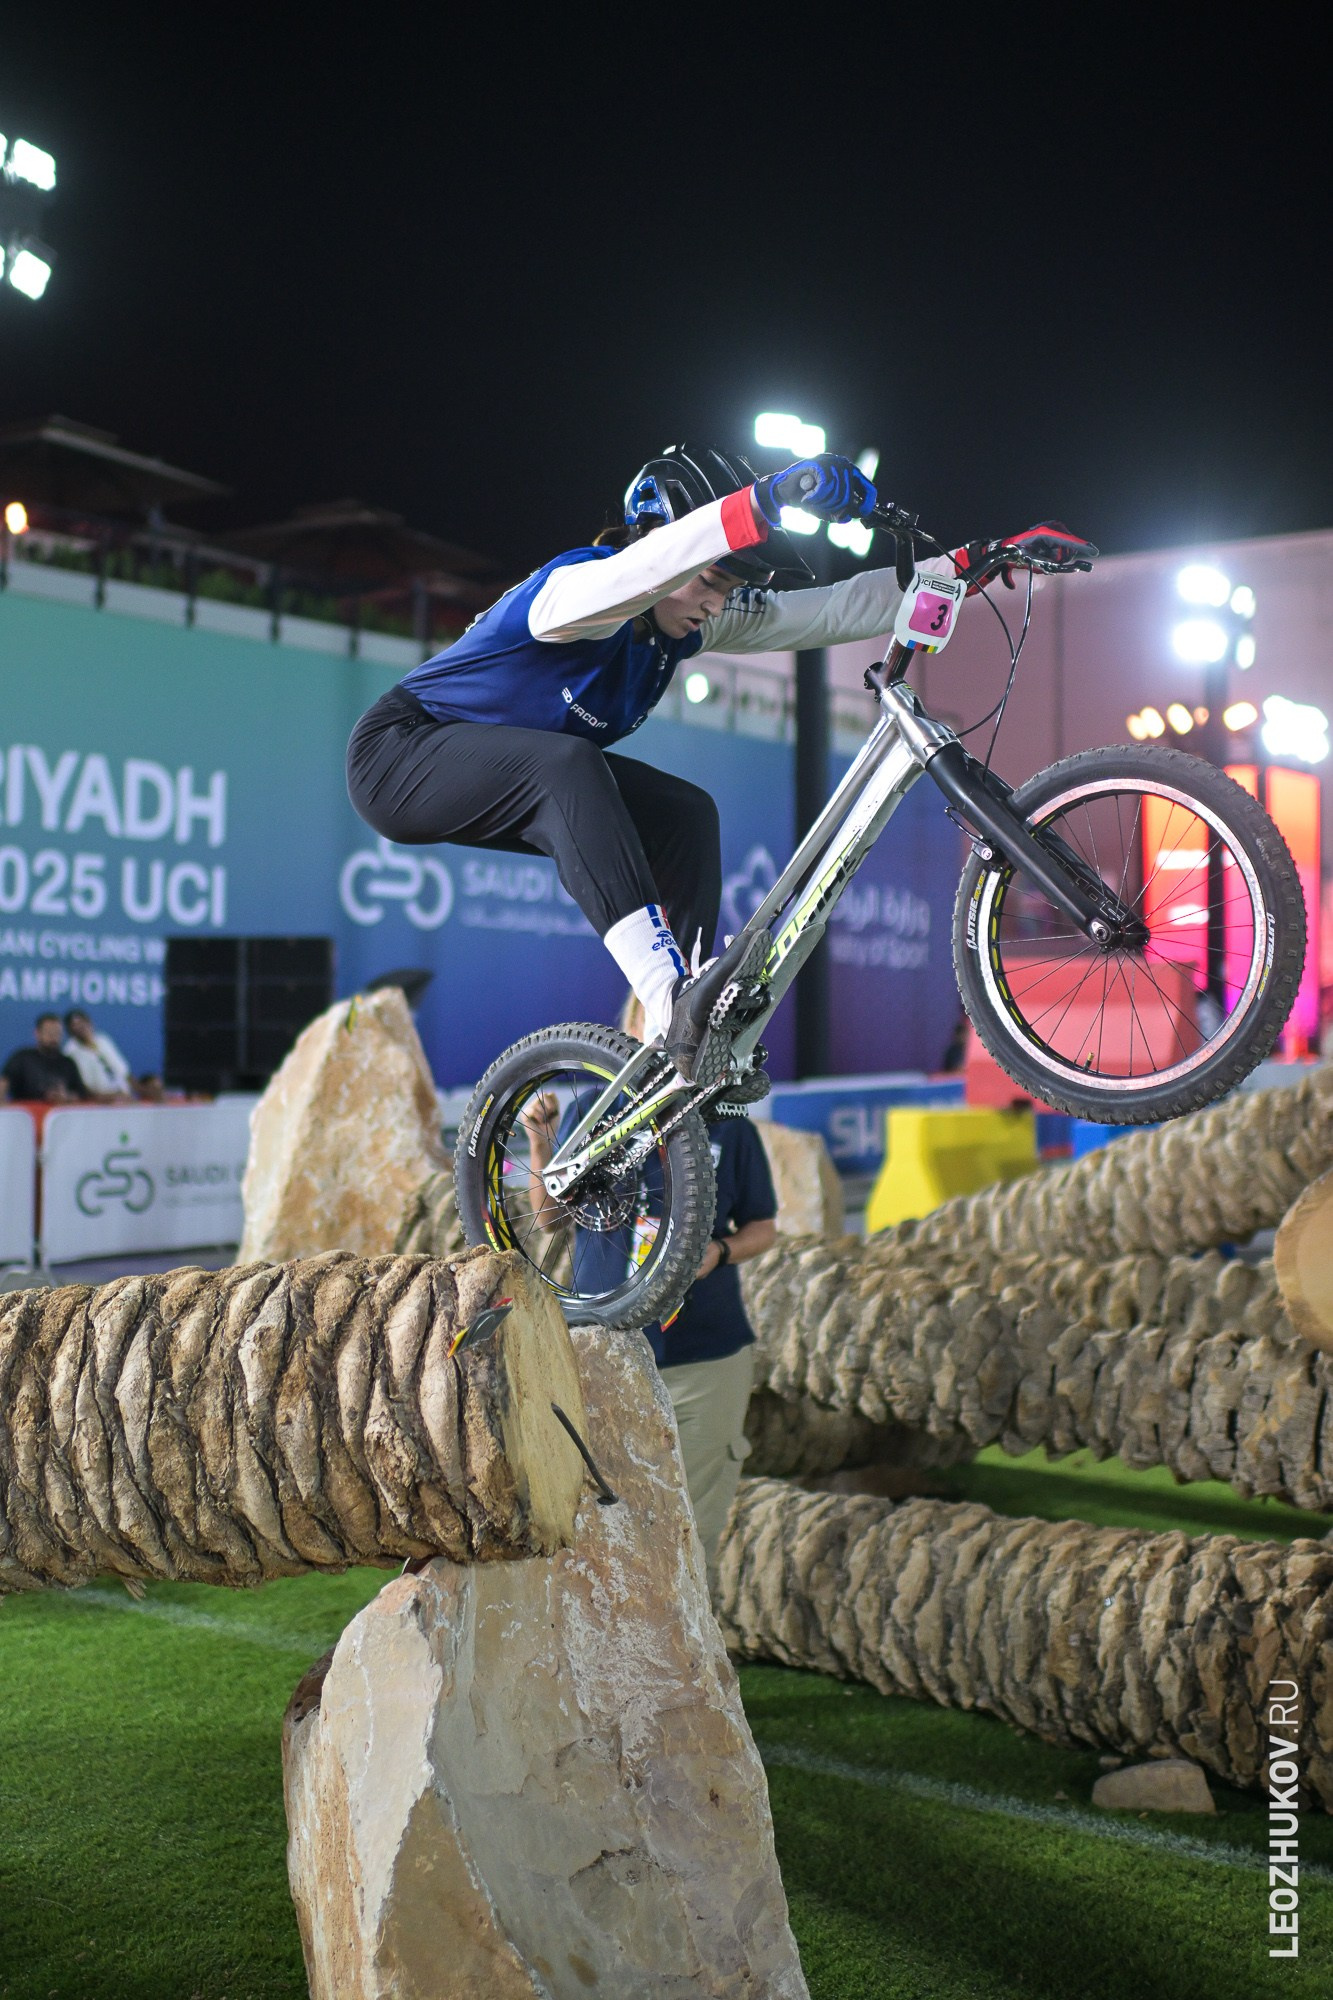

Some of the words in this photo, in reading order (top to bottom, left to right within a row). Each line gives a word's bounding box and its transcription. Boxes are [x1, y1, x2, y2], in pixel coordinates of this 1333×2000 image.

[930, 604, 948, 631] 3
[0, 743, 227, 848] IYADH
[121, 856, 226, 928] UCI
[462, 860, 553, 903] SAUDI
[967, 896, 979, 941] JITSIE
[38, 930, 141, 964] CYCLING
[1266, 921, 1275, 969] JITSIE
[470, 1114, 483, 1151] JITSIE
